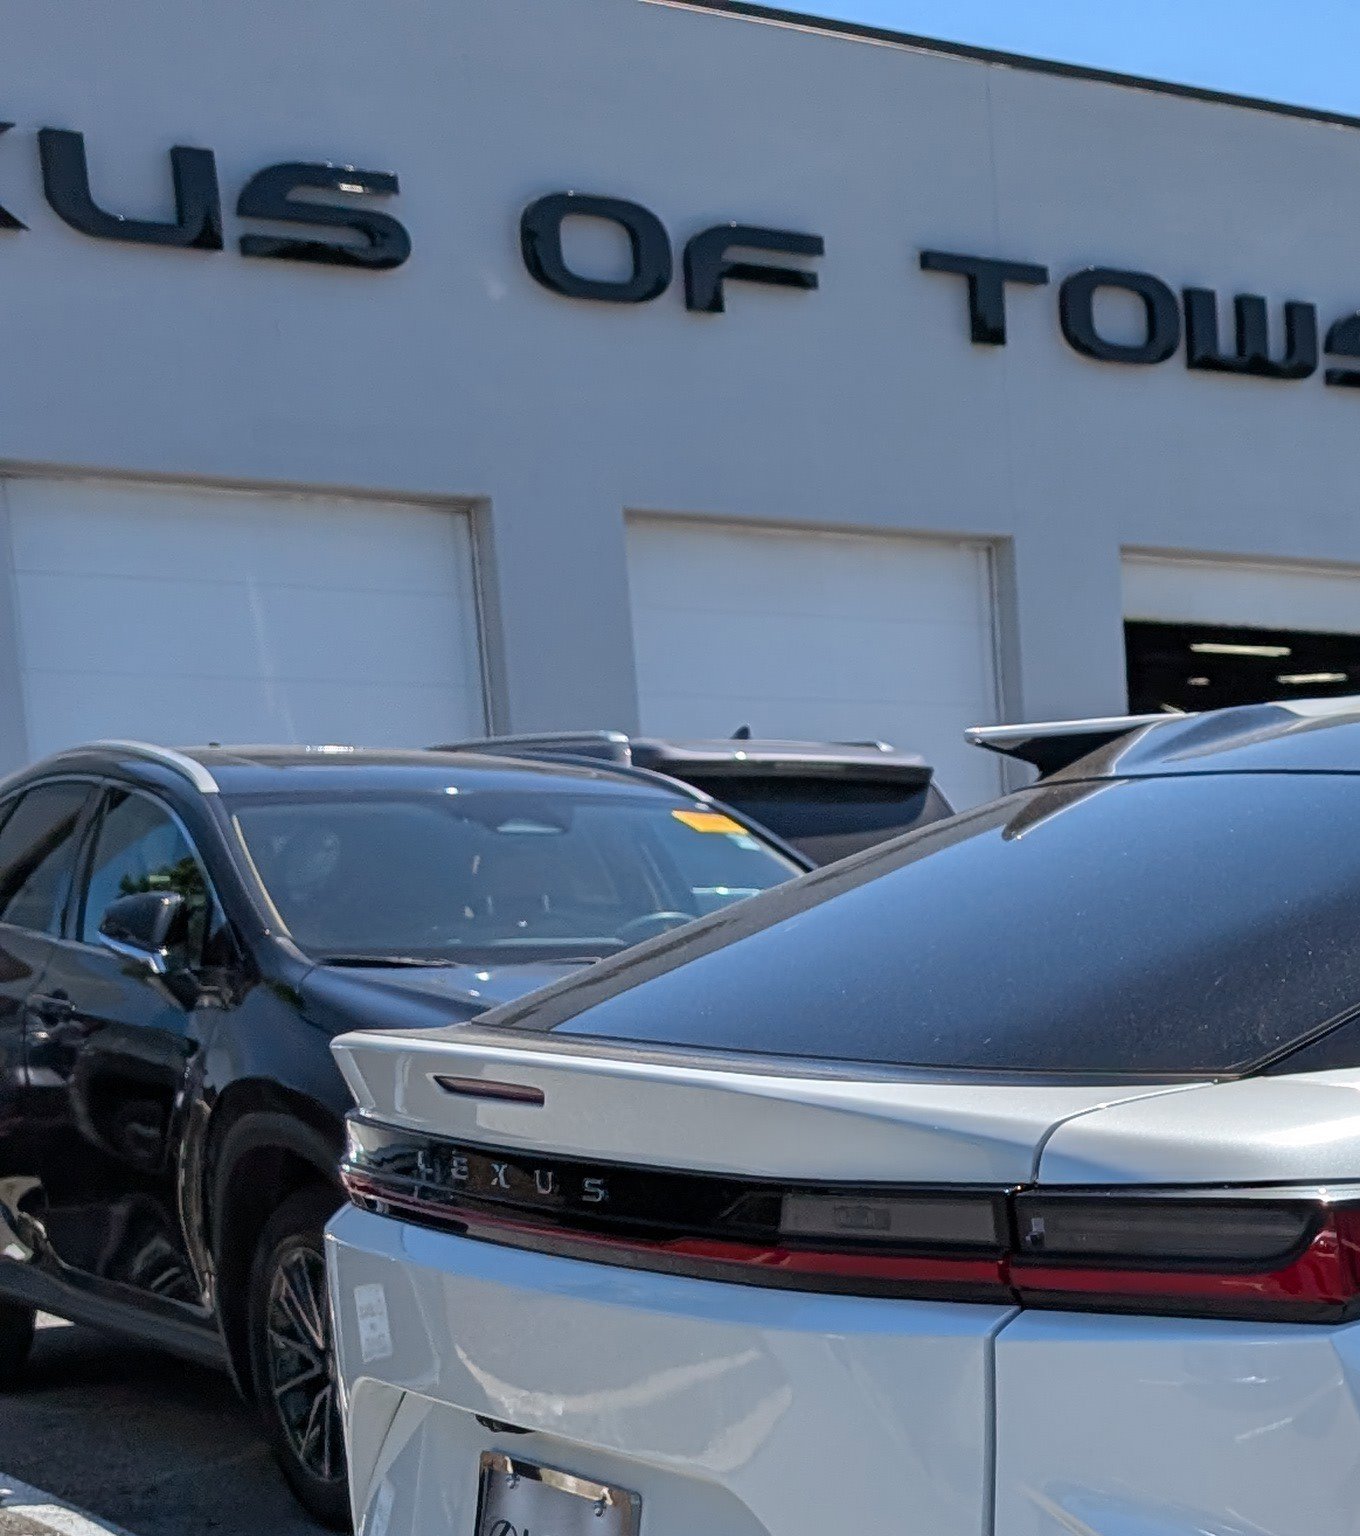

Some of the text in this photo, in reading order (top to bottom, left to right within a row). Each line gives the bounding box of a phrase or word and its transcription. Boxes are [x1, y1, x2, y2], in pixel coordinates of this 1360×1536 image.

[0, 122, 411, 269] US
[520, 192, 824, 313] OF
[417, 1150, 608, 1202] LEXUS
